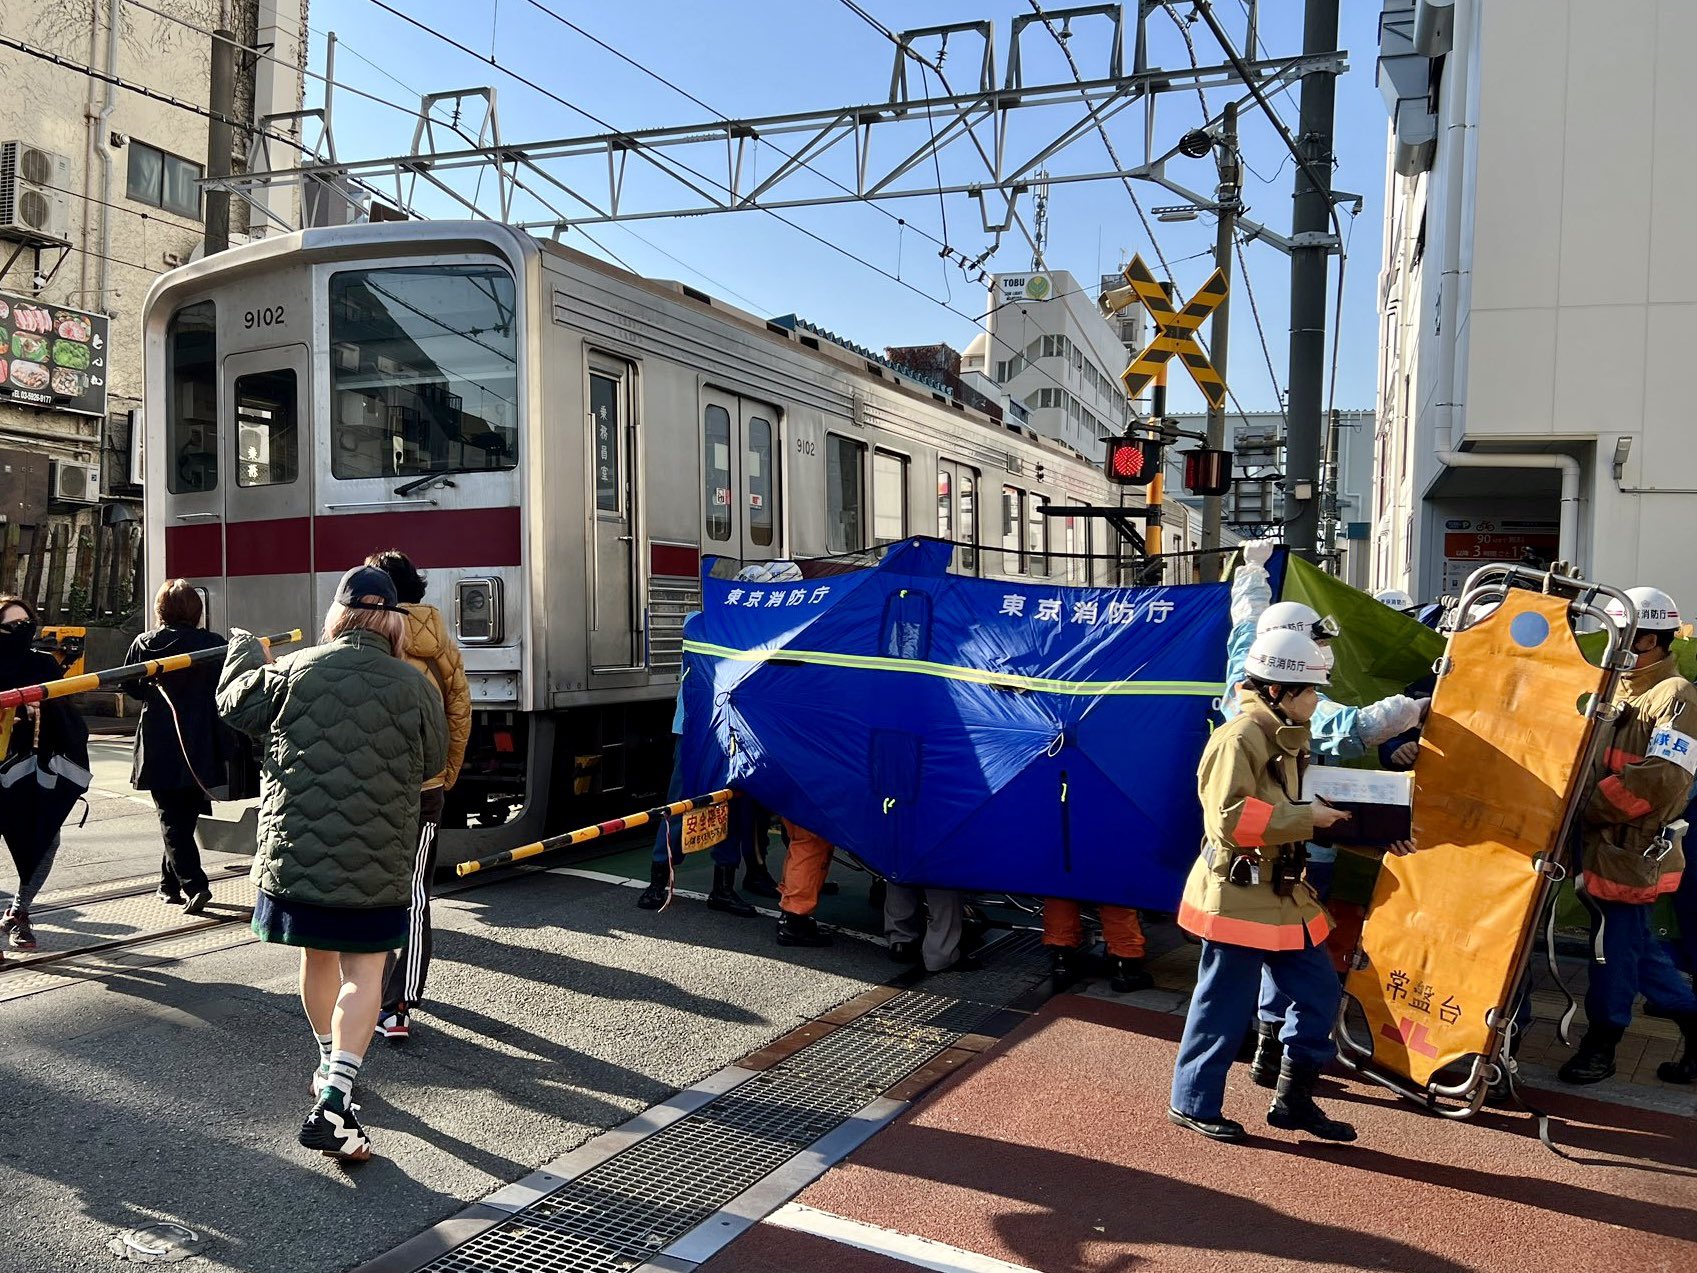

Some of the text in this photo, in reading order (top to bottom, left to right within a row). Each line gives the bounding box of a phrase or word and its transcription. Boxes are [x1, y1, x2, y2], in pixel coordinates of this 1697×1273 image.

[1003, 278, 1025, 287] TOBU
[244, 306, 285, 330] 9102
[599, 405, 609, 481] 乗務員室
[796, 438, 815, 457] 9102
[1476, 534, 1491, 544] 90
[1472, 545, 1481, 557] 3
[724, 586, 830, 608] 東京消防庁
[999, 593, 1175, 625] 東京消防庁
[1259, 654, 1306, 672] 東京消防庁
[1649, 732, 1690, 755] 隊長
[1386, 969, 1462, 1025] 常盤台
